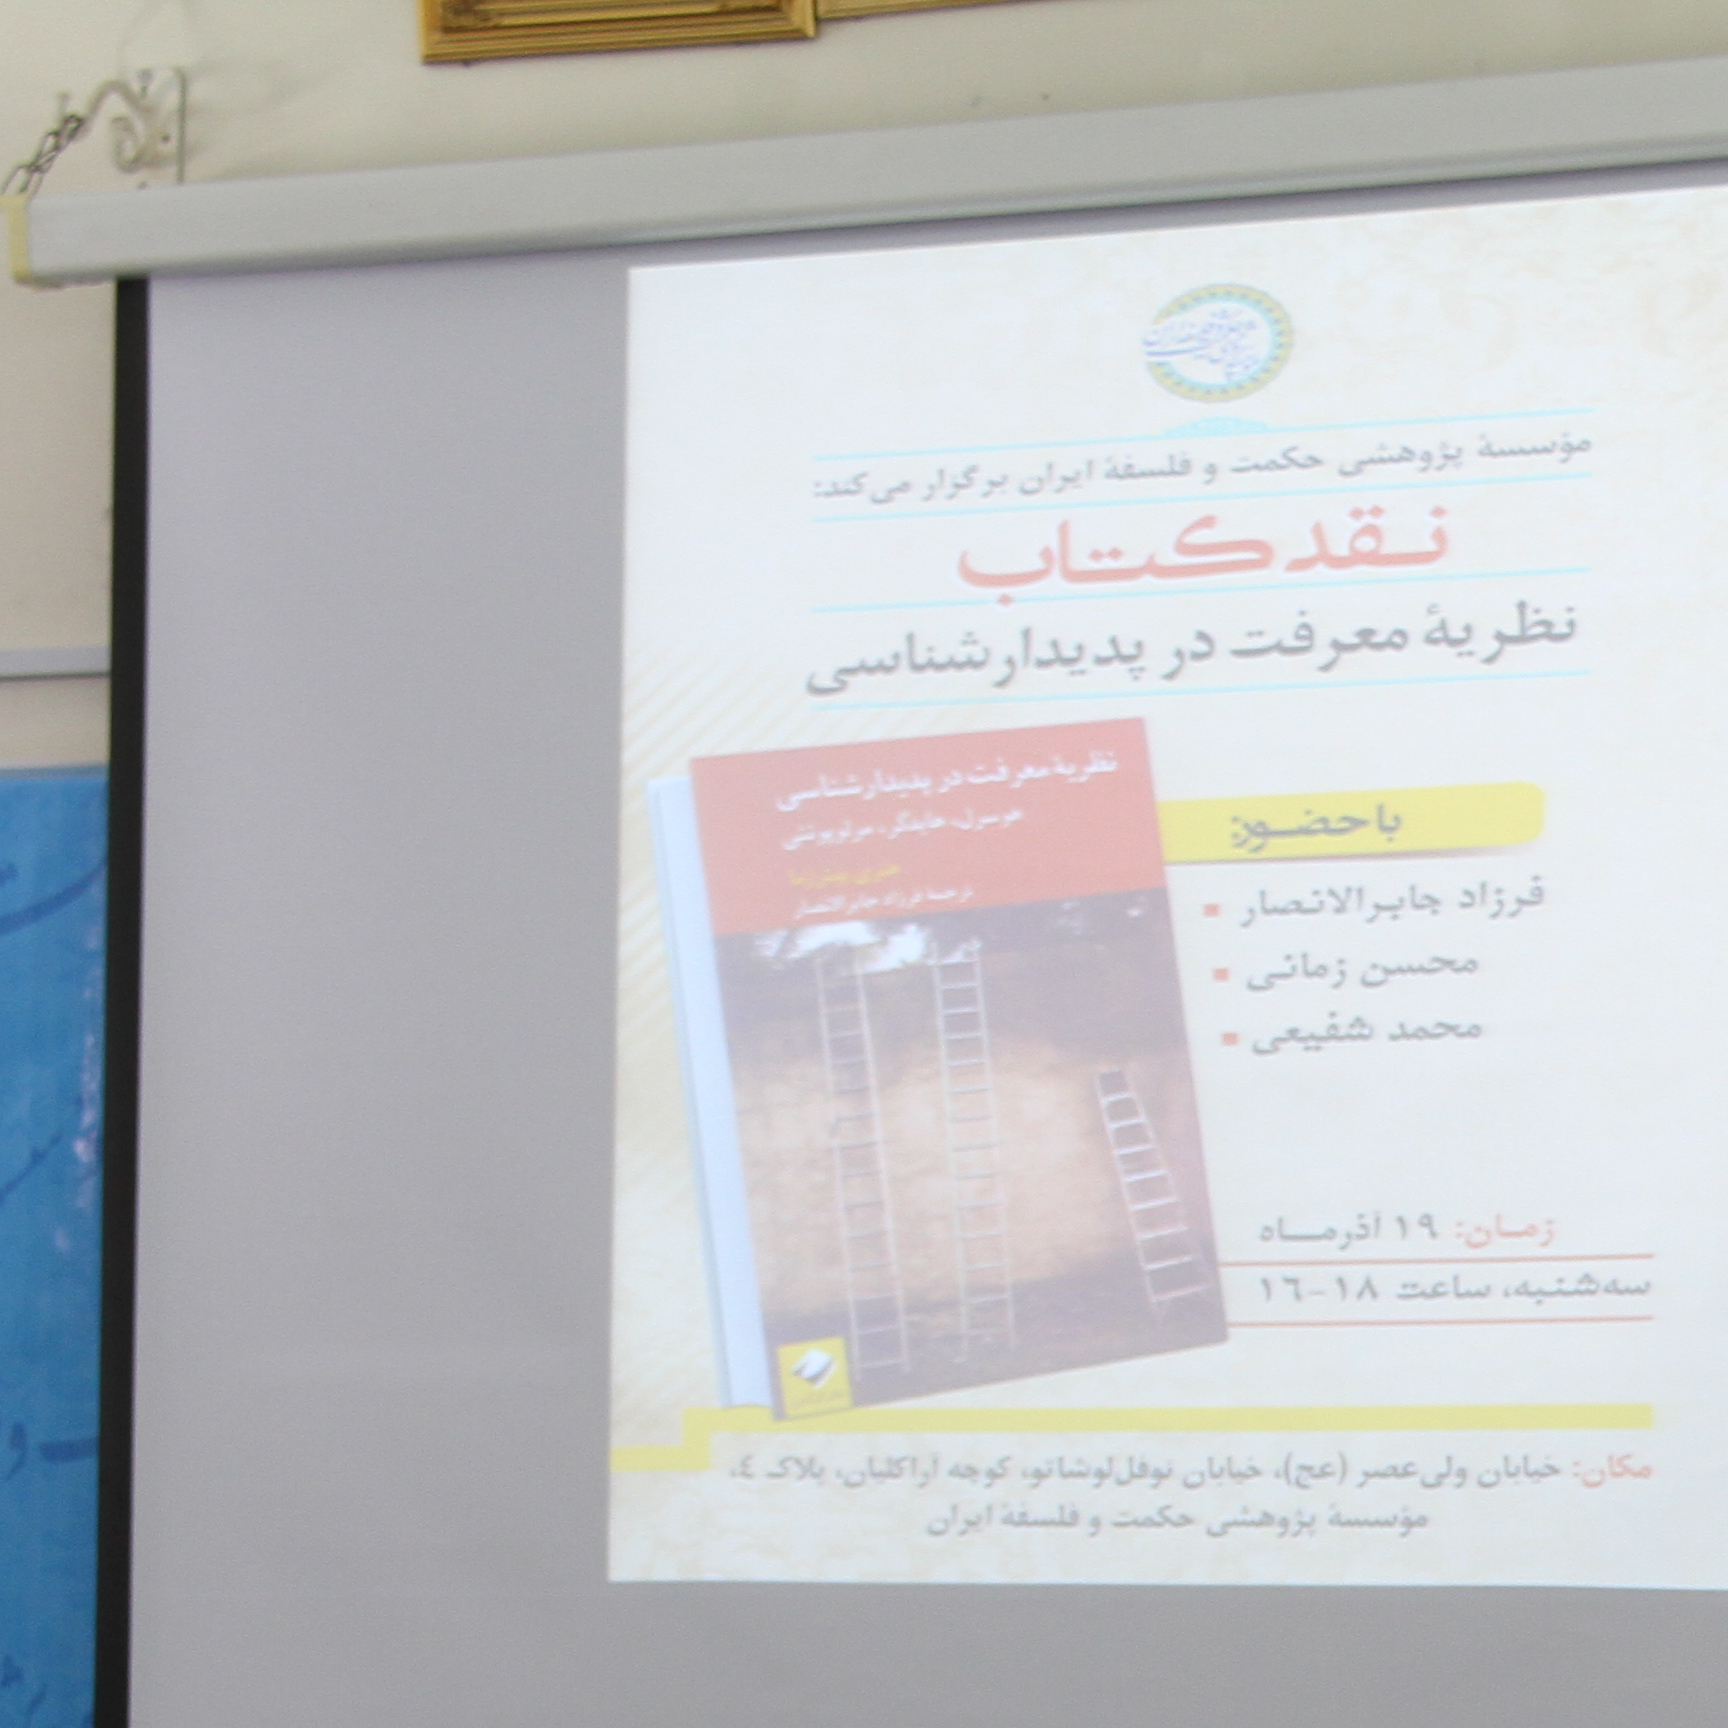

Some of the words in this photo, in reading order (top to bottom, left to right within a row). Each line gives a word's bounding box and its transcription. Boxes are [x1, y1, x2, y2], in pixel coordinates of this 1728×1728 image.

[1017, 459, 1094, 496] ایران
[1201, 460, 1218, 485] و
[1229, 445, 1323, 474] حکمت
[1337, 441, 1463, 478] پژوهشی
[922, 463, 1008, 502] برگزار
[1283, 504, 1450, 573] نقد
[956, 514, 1276, 608] کتاب
[1159, 622, 1215, 682] در
[1229, 608, 1408, 674] معرفت
[804, 625, 1147, 699] پدیدارشناسی
[1375, 802, 1402, 841] با
[1458, 874, 1547, 919] فرزاد
[1245, 951, 1349, 992] زمانی
[1359, 953, 1480, 988] محسن
[1250, 1010, 1373, 1055] شفیعی
[1387, 1018, 1483, 1043] محمد
[1454, 1211, 1556, 1250] زمان:
[1395, 1273, 1492, 1300] ساعت
[765, 1452, 826, 1487] پلاک
[947, 1453, 1012, 1490] کوچه
[1182, 1455, 1264, 1490] خیابان
[1476, 1455, 1561, 1489] خیابان
[1572, 1453, 1654, 1489] مکان:
[926, 1502, 993, 1537] ایران
[1088, 1515, 1102, 1538] و
[1110, 1503, 1195, 1527] حکمت
[1205, 1504, 1319, 1538] پژوهشی
